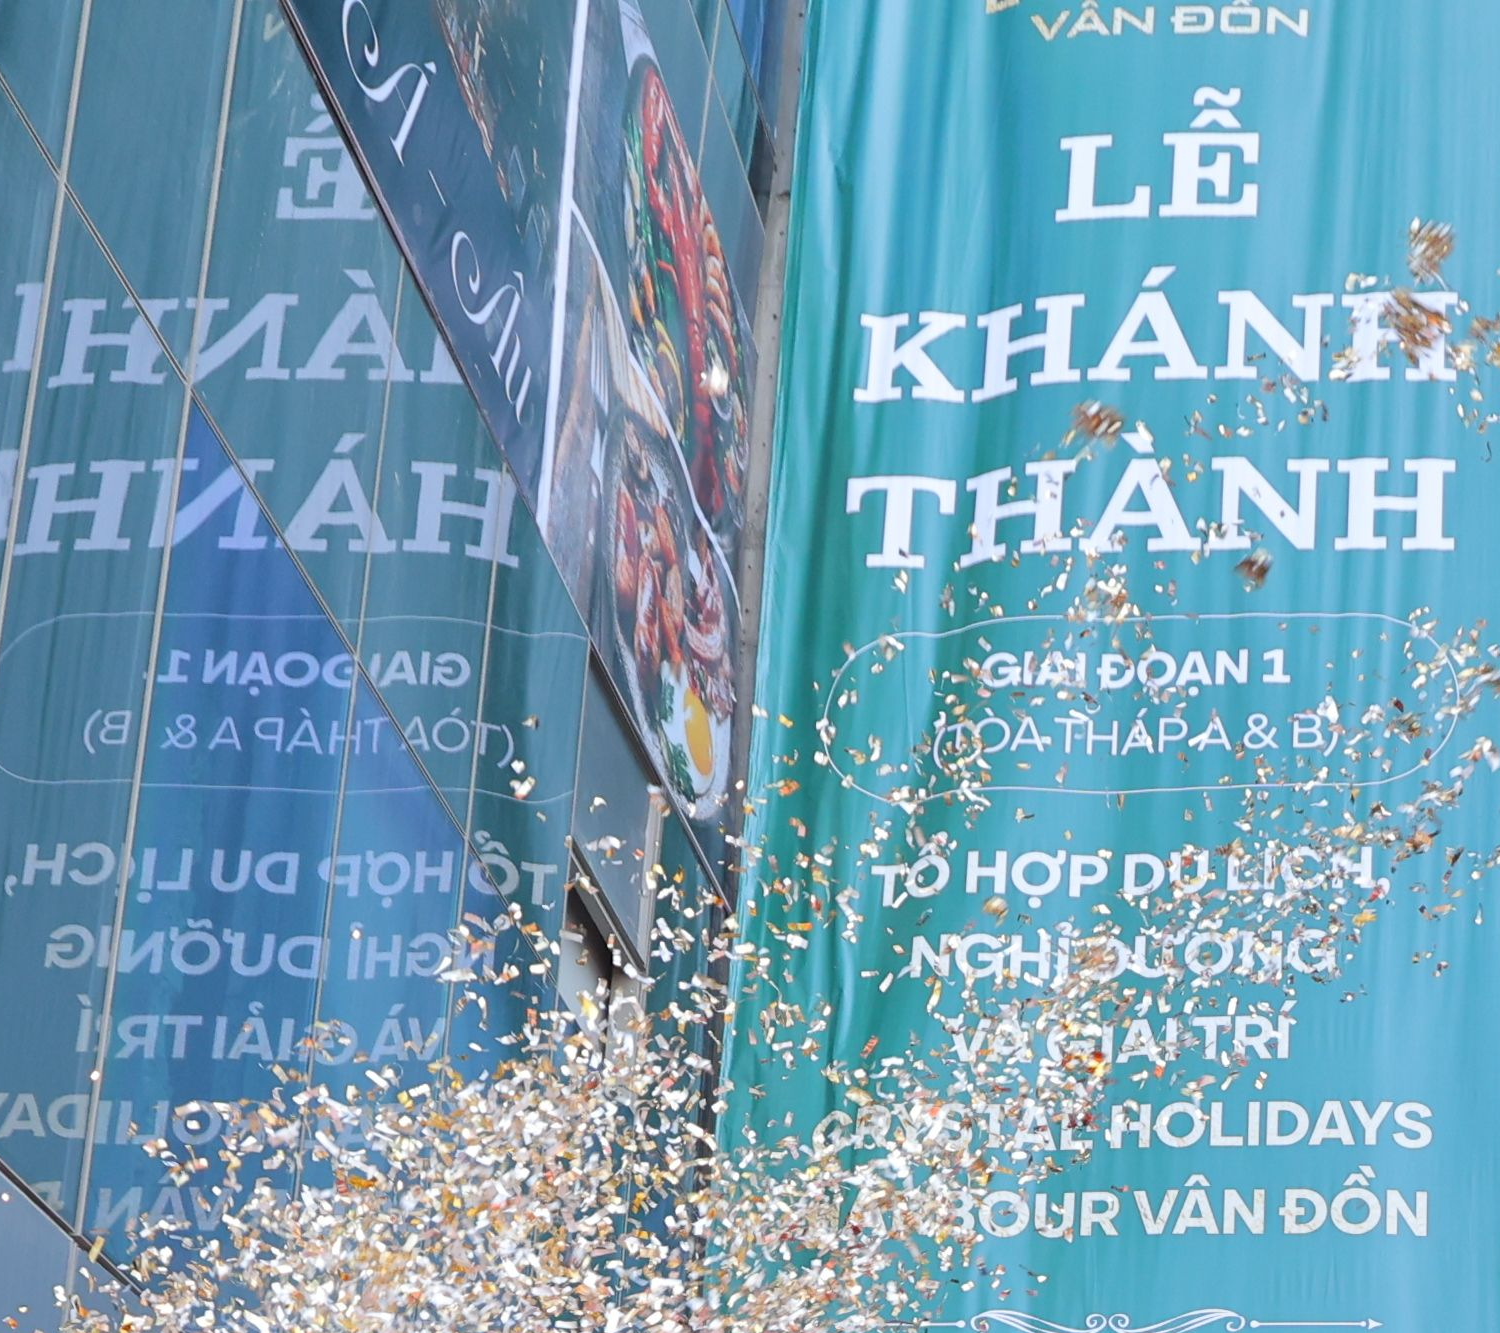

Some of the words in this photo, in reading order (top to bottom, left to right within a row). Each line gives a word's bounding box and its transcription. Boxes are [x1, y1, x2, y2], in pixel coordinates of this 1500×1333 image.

[1031, 0, 1155, 41] VÂN
[1055, 86, 1260, 222] LỄ
[853, 266, 1458, 403] KHÁNH
[846, 432, 1456, 569] THÀNH
[980, 650, 1086, 689] GIAI
[1097, 648, 1248, 696] ĐOẠN
[1262, 648, 1291, 683] 1
[1054, 708, 1189, 756] THÁP
[1198, 716, 1232, 751] A
[1243, 713, 1279, 750] &
[1292, 713, 1339, 757] B)
[965, 849, 1109, 909] HỢP
[1122, 852, 1209, 897] DU
[1111, 1100, 1435, 1150] HOLIDAYS
[1141, 1174, 1265, 1235] VÂN
[1280, 1165, 1429, 1237] ĐỒN
